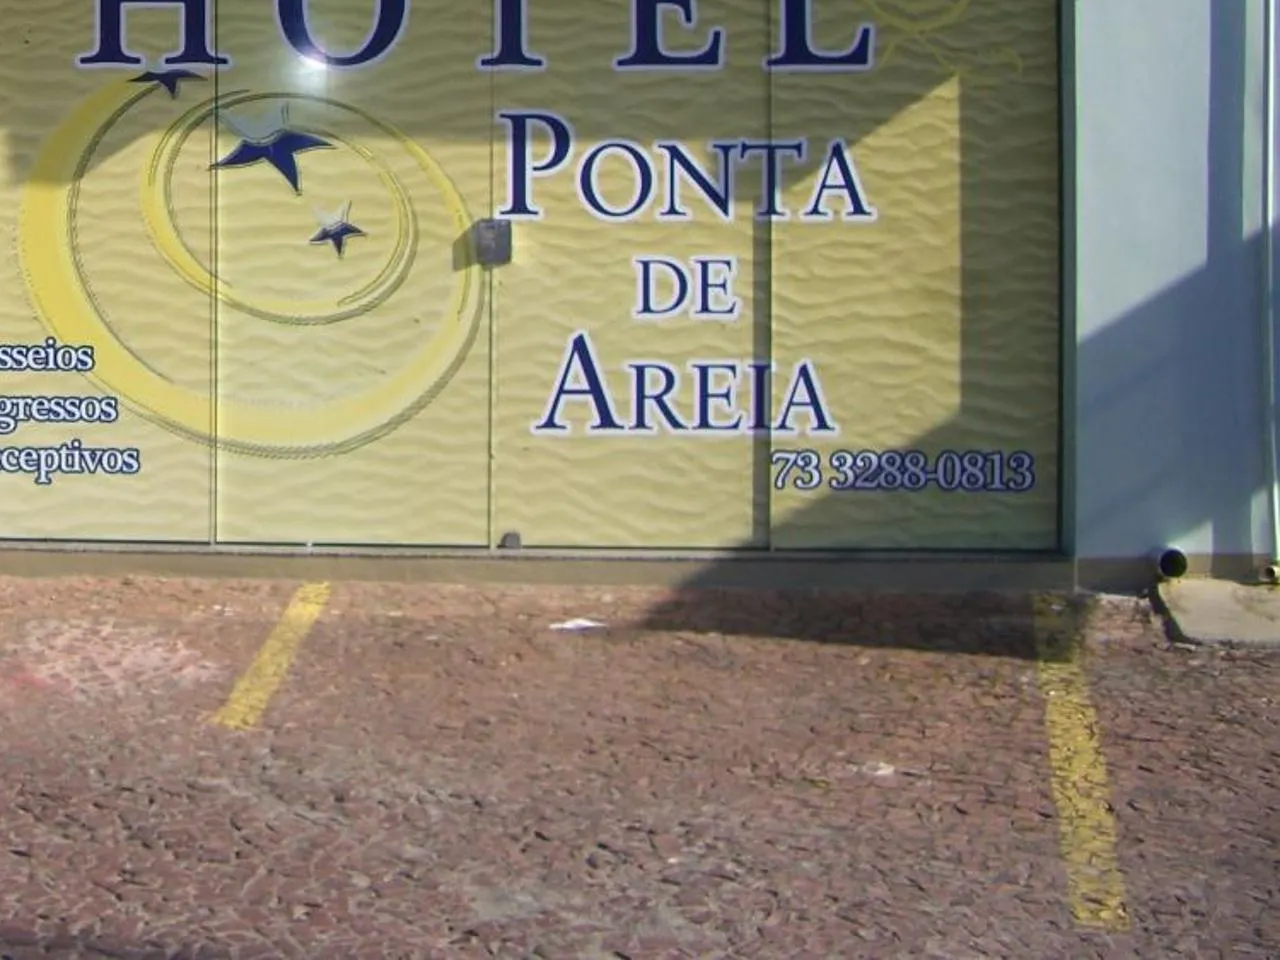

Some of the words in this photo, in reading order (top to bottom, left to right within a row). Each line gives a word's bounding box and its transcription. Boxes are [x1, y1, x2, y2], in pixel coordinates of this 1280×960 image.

[499, 112, 874, 218] PONTA
[635, 258, 738, 315] DE
[534, 333, 836, 431] AREIA
[771, 450, 820, 490] 73
[829, 450, 1035, 491] 3288-0813
